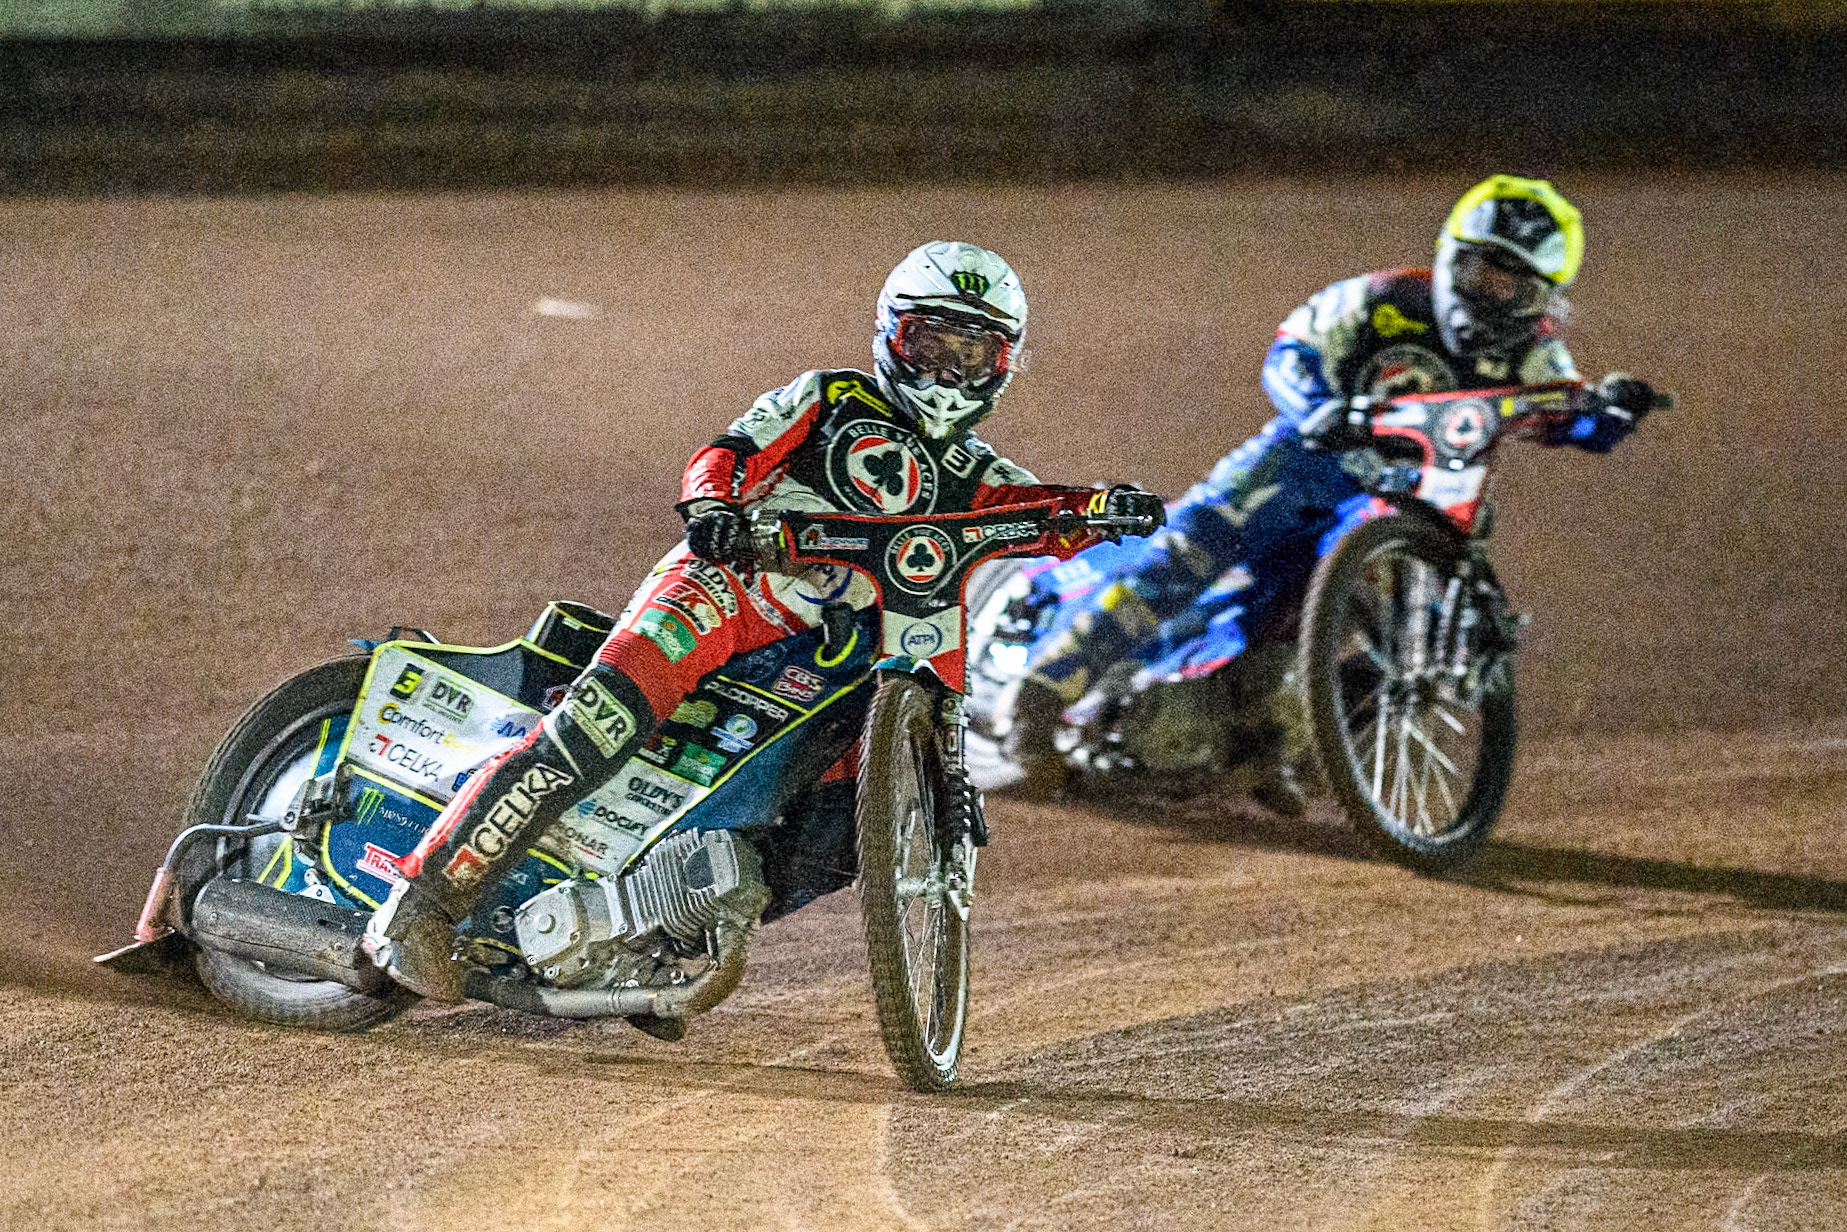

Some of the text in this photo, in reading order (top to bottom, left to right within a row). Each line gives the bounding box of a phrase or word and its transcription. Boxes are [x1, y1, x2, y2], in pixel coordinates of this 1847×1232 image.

[847, 424, 888, 438] BELLE
[919, 463, 934, 500] ACES
[431, 681, 472, 714] DVR
[577, 685, 627, 741] DVR
[379, 703, 446, 745] Comfort
[387, 744, 443, 783] CELKA
[475, 764, 572, 857] CELKA
